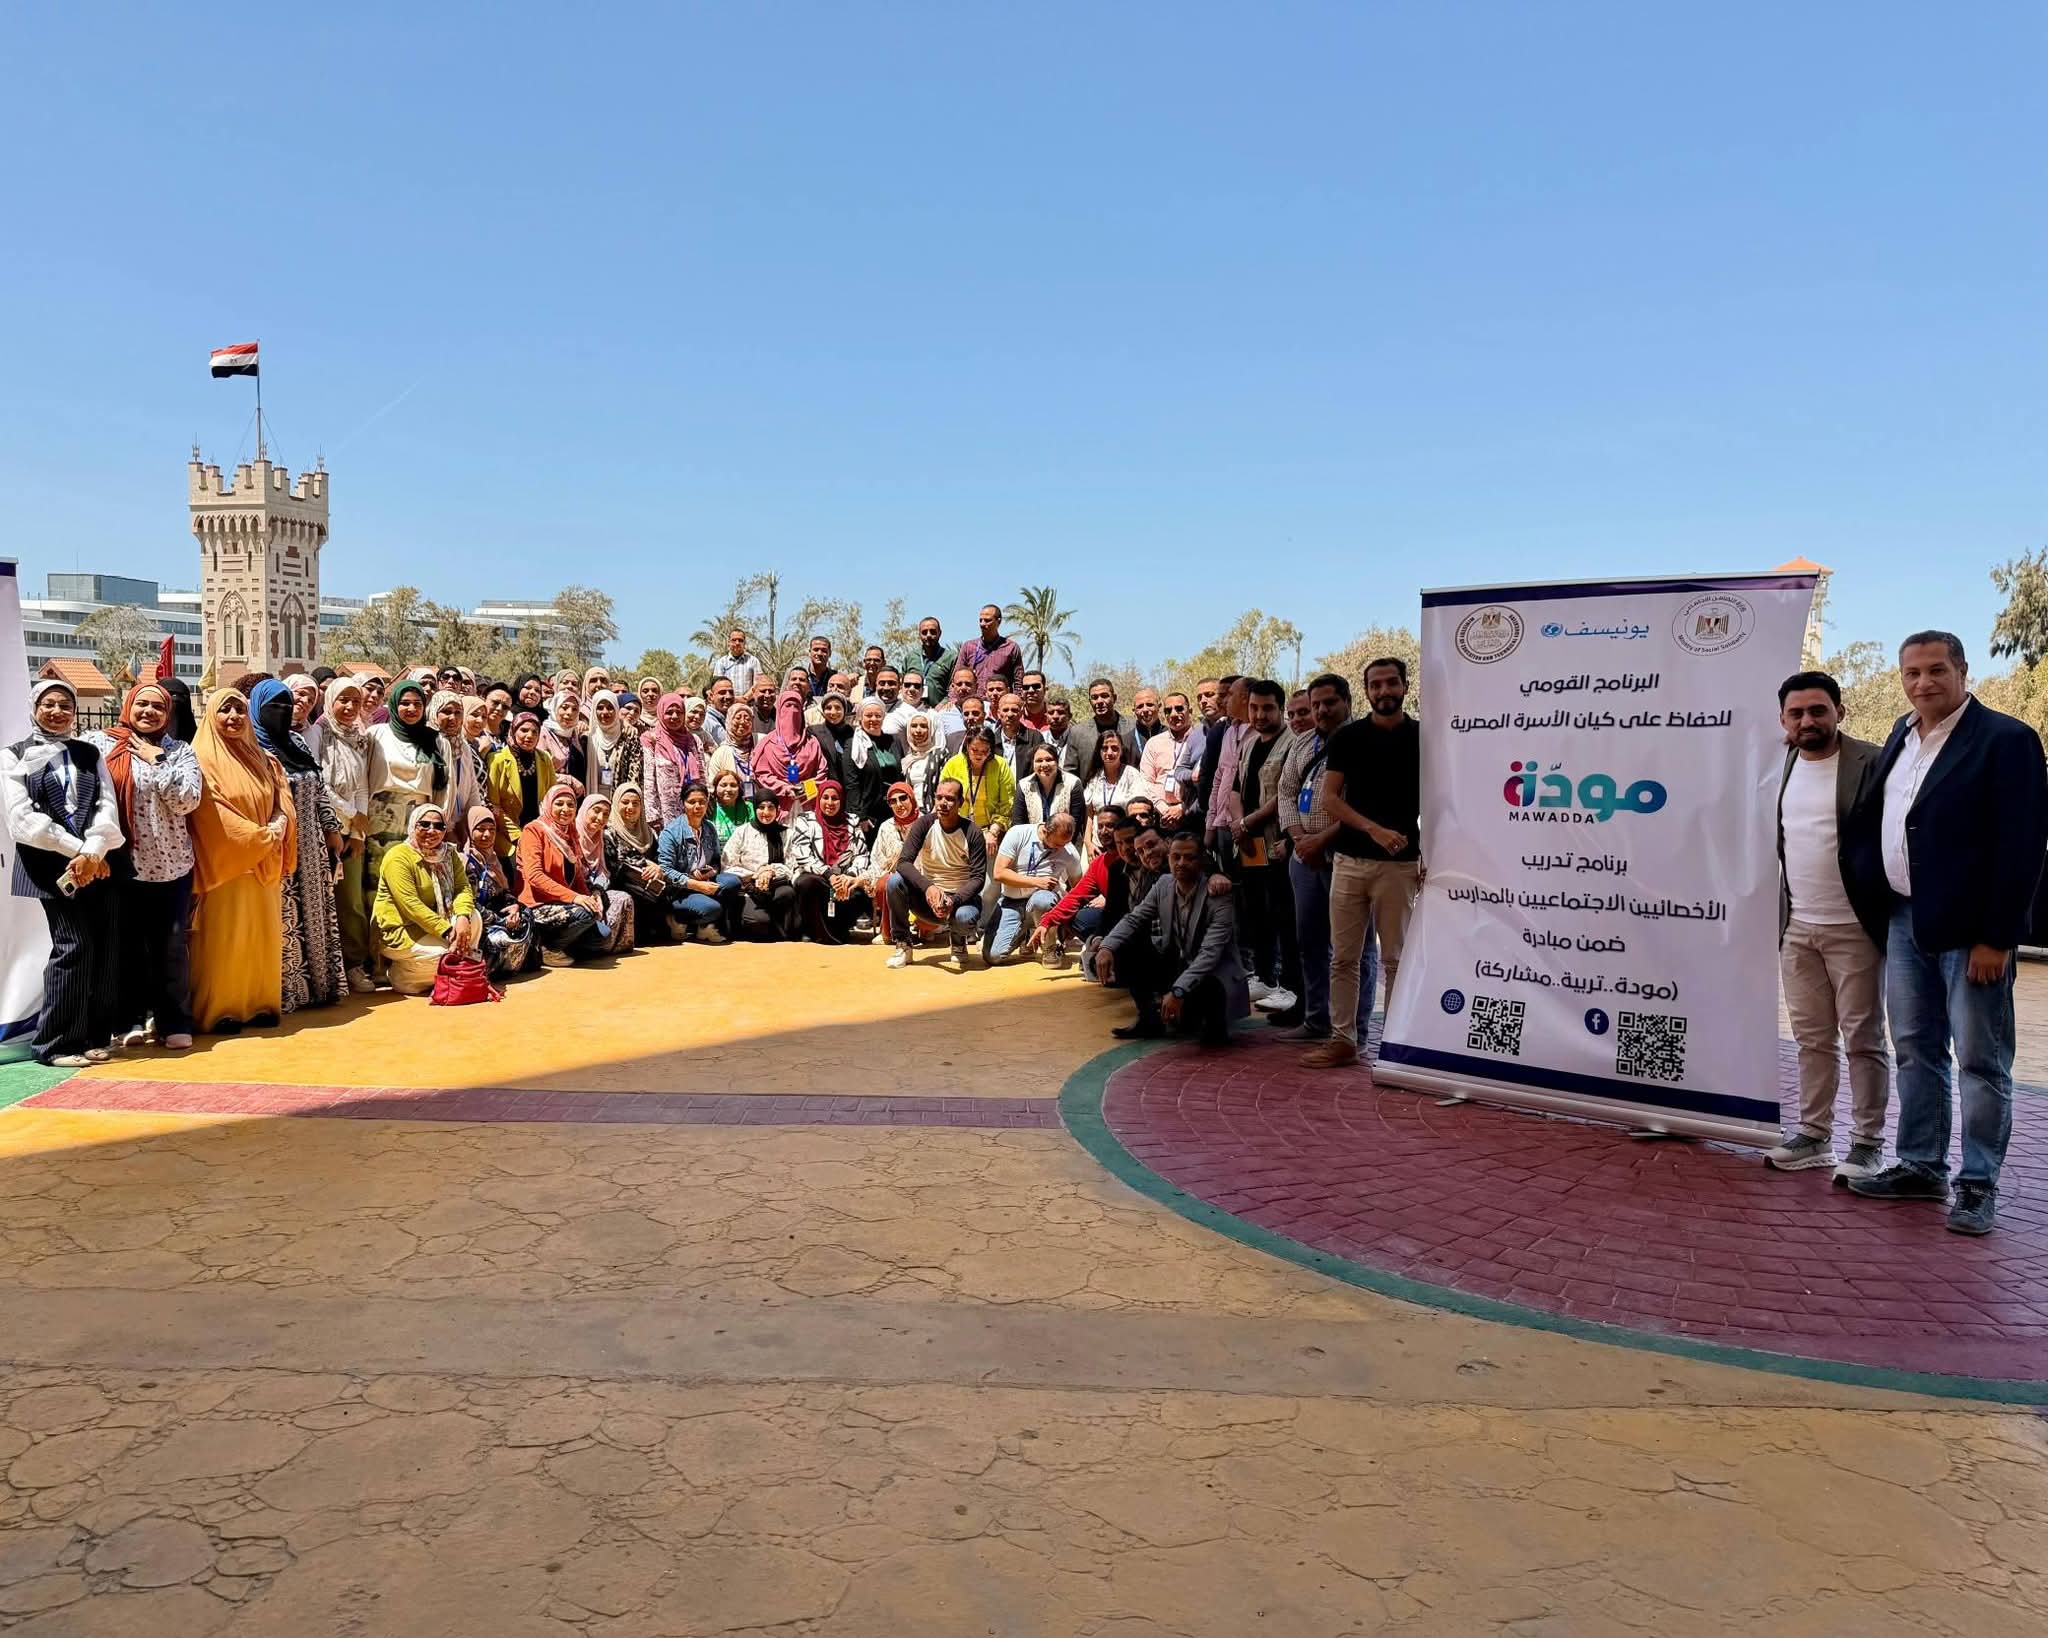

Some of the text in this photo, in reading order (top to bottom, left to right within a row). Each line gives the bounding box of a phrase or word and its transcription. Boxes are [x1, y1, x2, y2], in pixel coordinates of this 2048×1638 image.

[1564, 618, 1649, 640] يونيسف
[1519, 672, 1660, 697] البرنامج القومي
[1450, 709, 1732, 733] للحفاظ على كيان الأسرة المصرية
[1508, 811, 1595, 824] MAWADDA
[1521, 852, 1628, 877] برنامج تدريب
[1447, 885, 1726, 921] الأخصائيين الاجتماعيين بالمدارس
[1522, 927, 1626, 953] ضمن مبادرة
